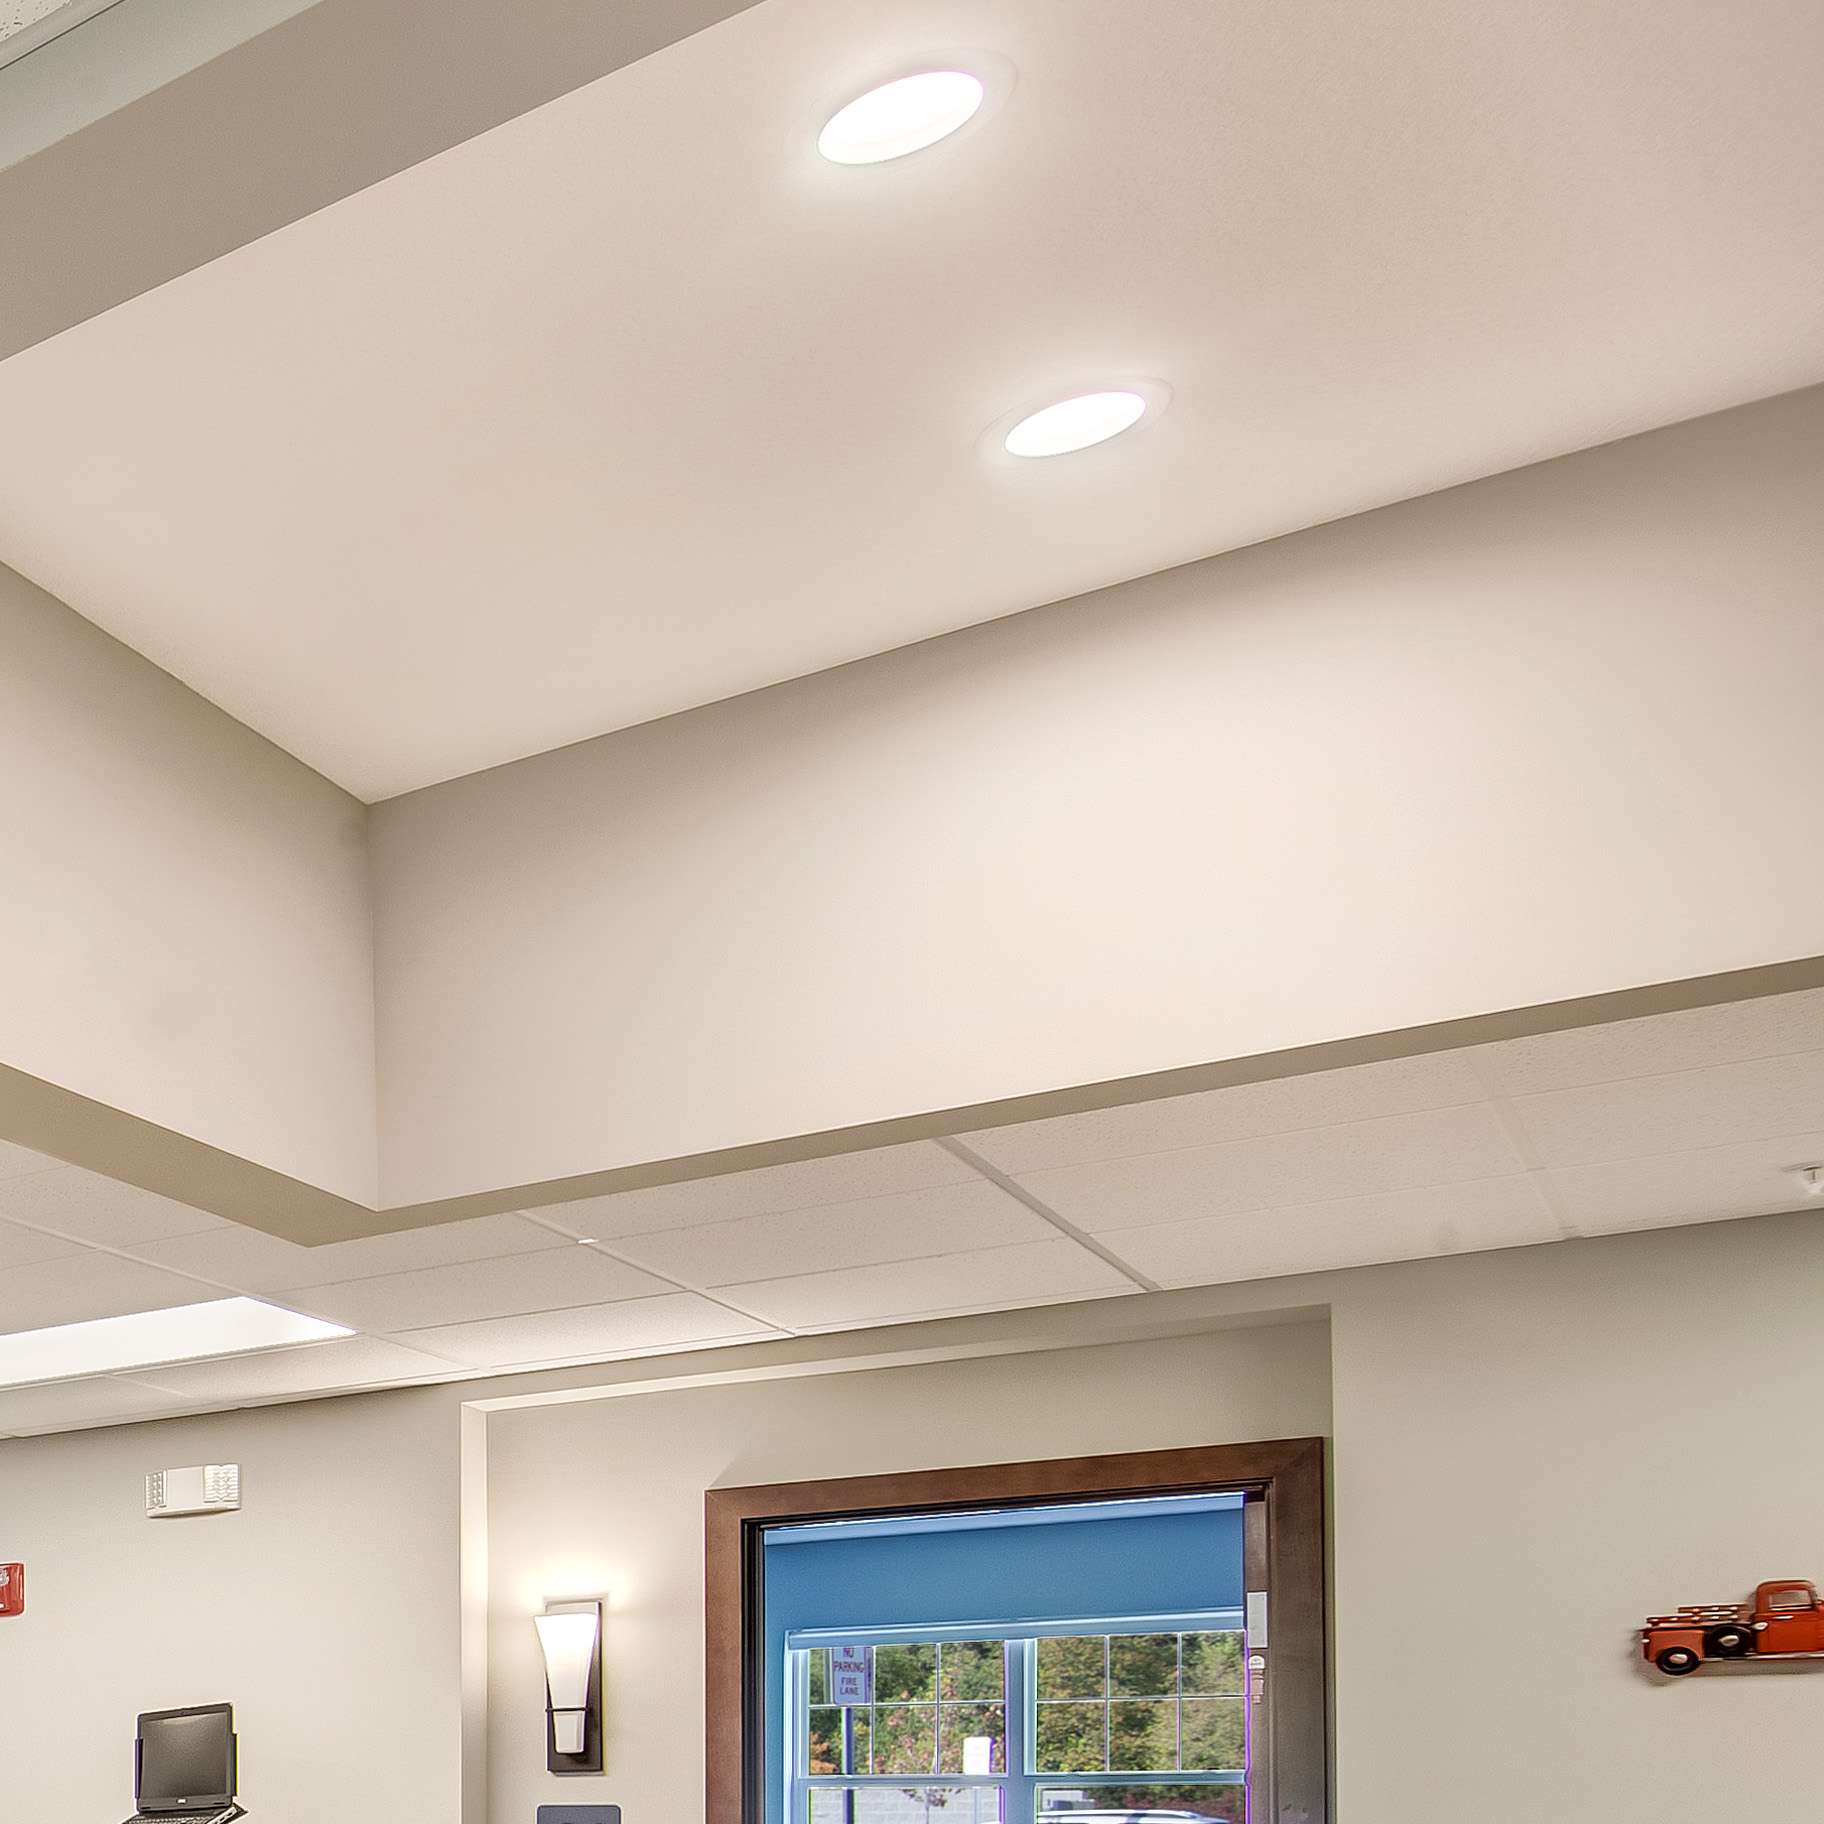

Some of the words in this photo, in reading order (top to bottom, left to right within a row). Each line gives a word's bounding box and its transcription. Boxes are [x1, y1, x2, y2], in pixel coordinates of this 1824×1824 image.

[833, 1661, 865, 1672] PARKING
[841, 1677, 857, 1686] FIRE
[840, 1687, 859, 1695] LANE
